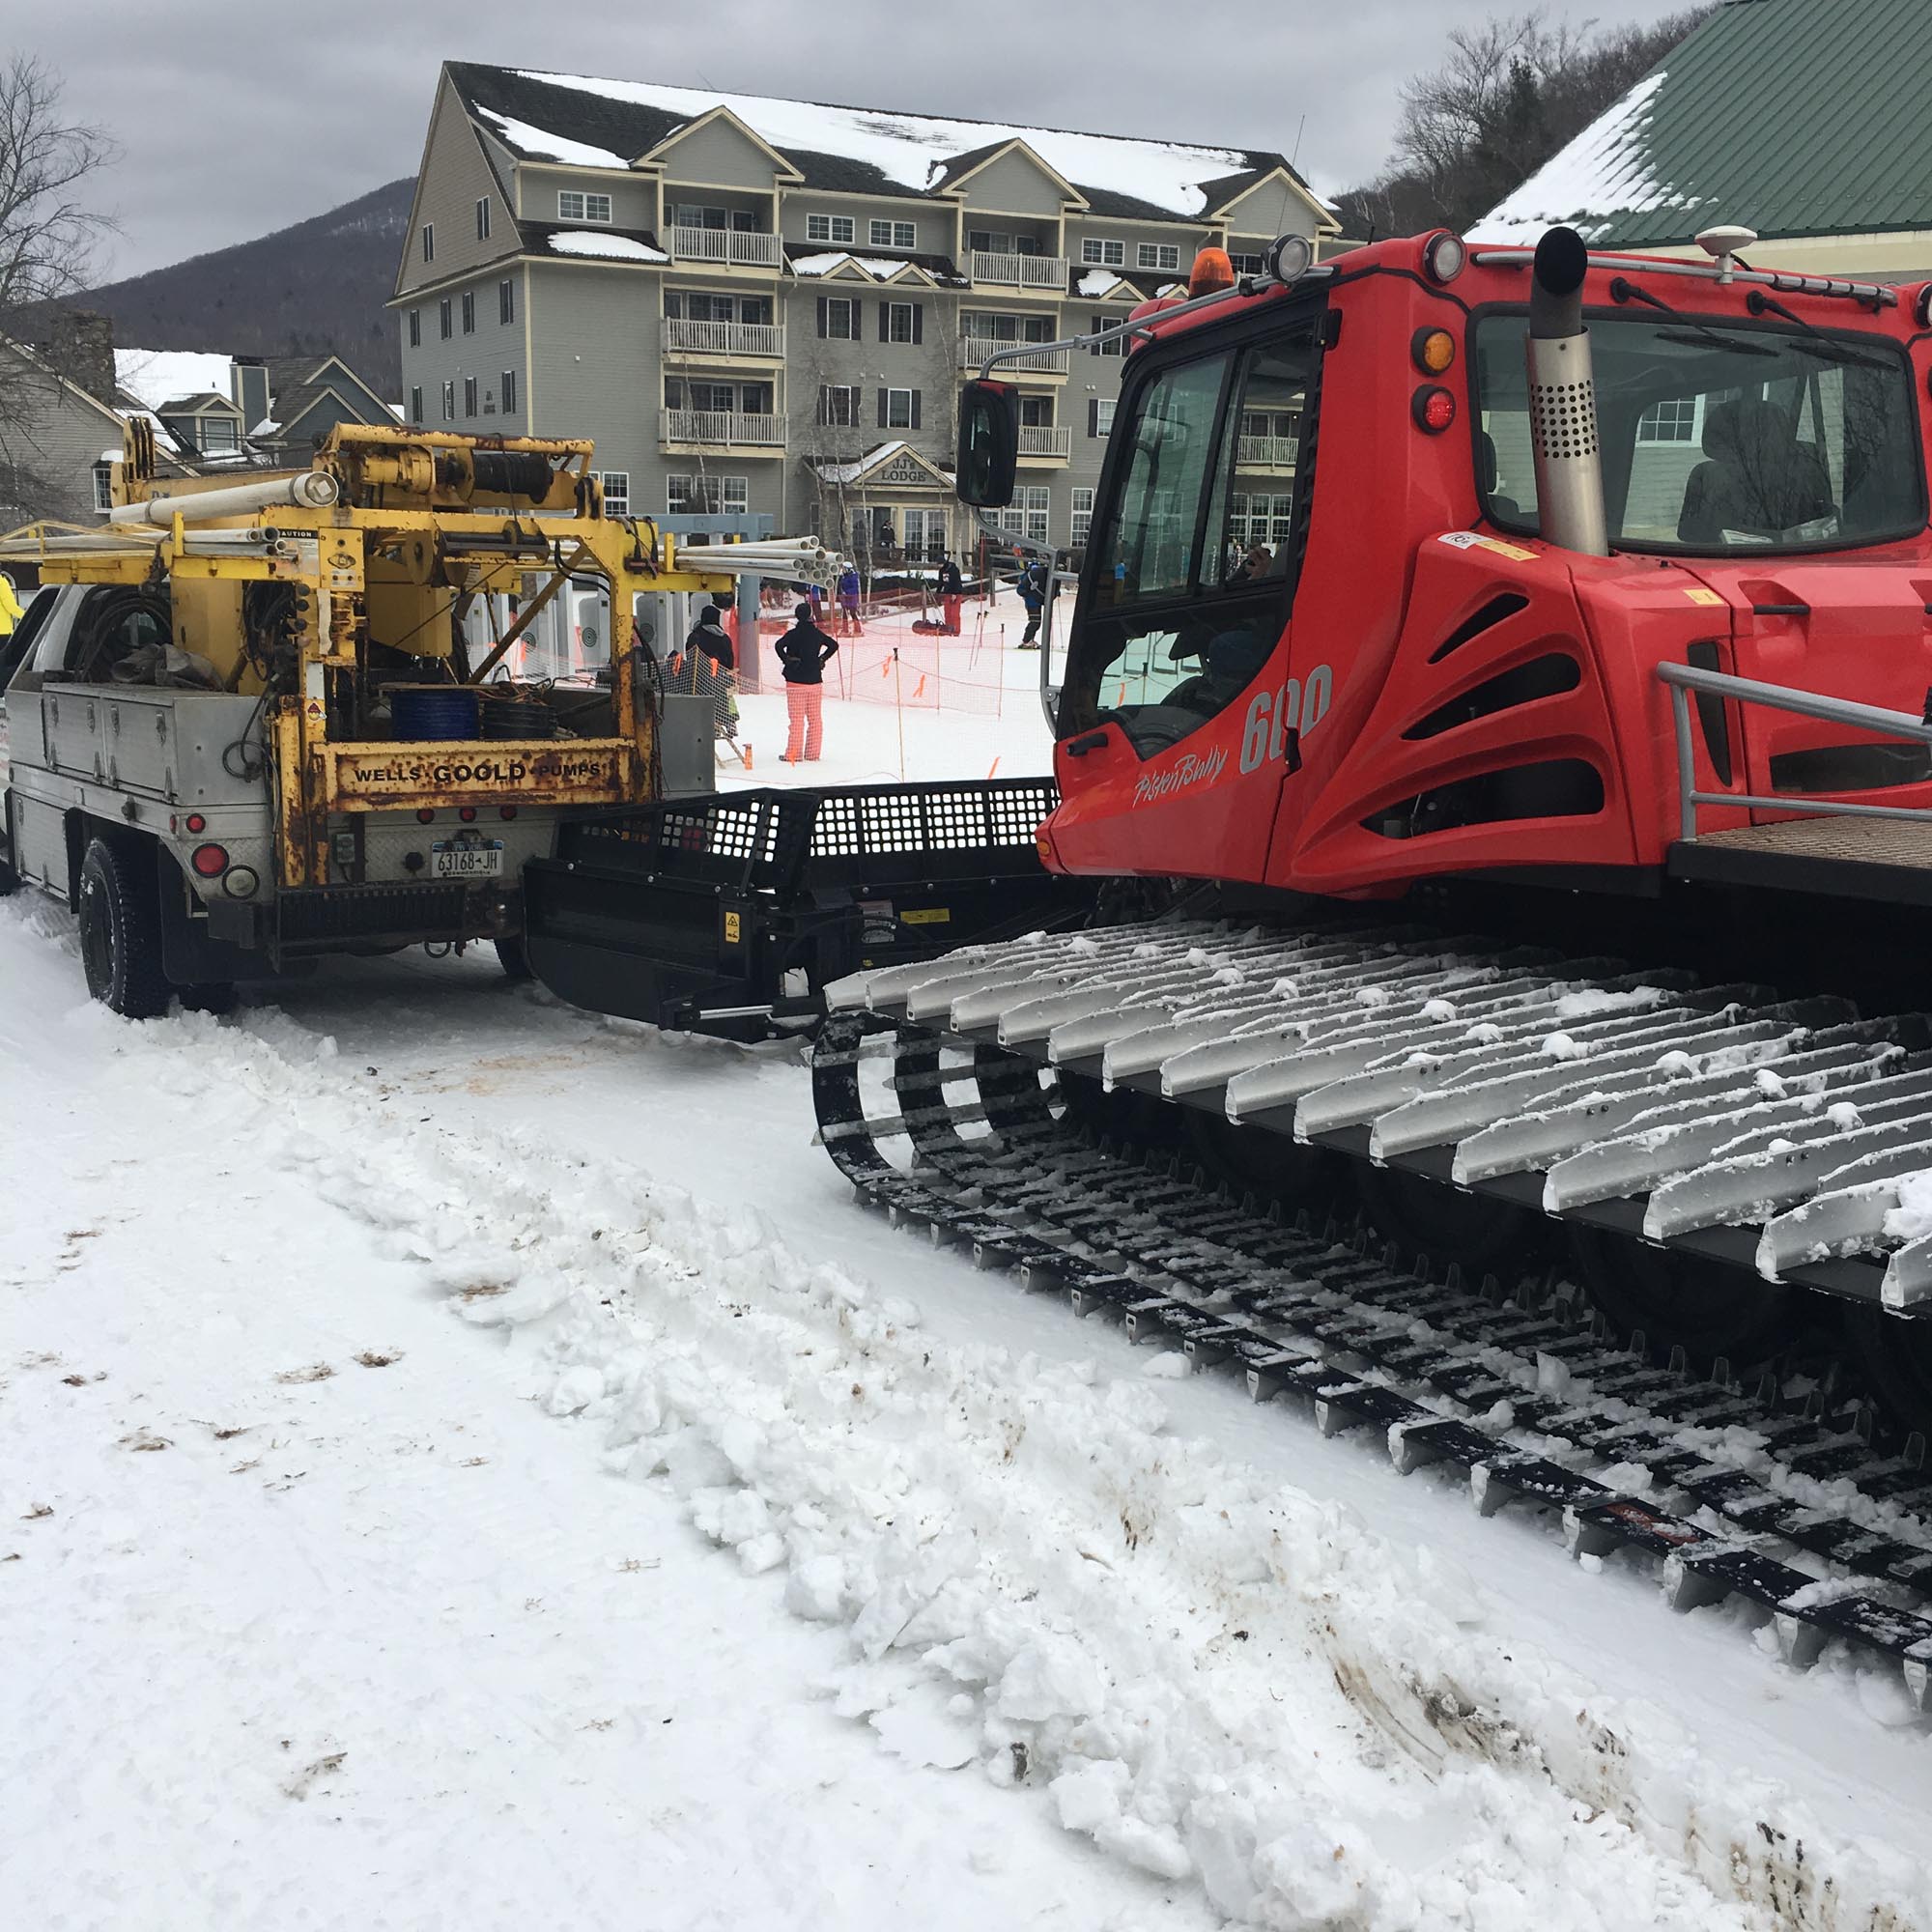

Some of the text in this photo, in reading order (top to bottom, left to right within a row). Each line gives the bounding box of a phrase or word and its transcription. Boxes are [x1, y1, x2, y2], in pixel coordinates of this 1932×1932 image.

[893, 459, 916, 469] JJ's
[881, 470, 926, 482] LODGE
[1239, 664, 1332, 775] 600
[354, 763, 601, 782] WELLS GOOLD PUMPS
[1132, 744, 1229, 809] PistenBully
